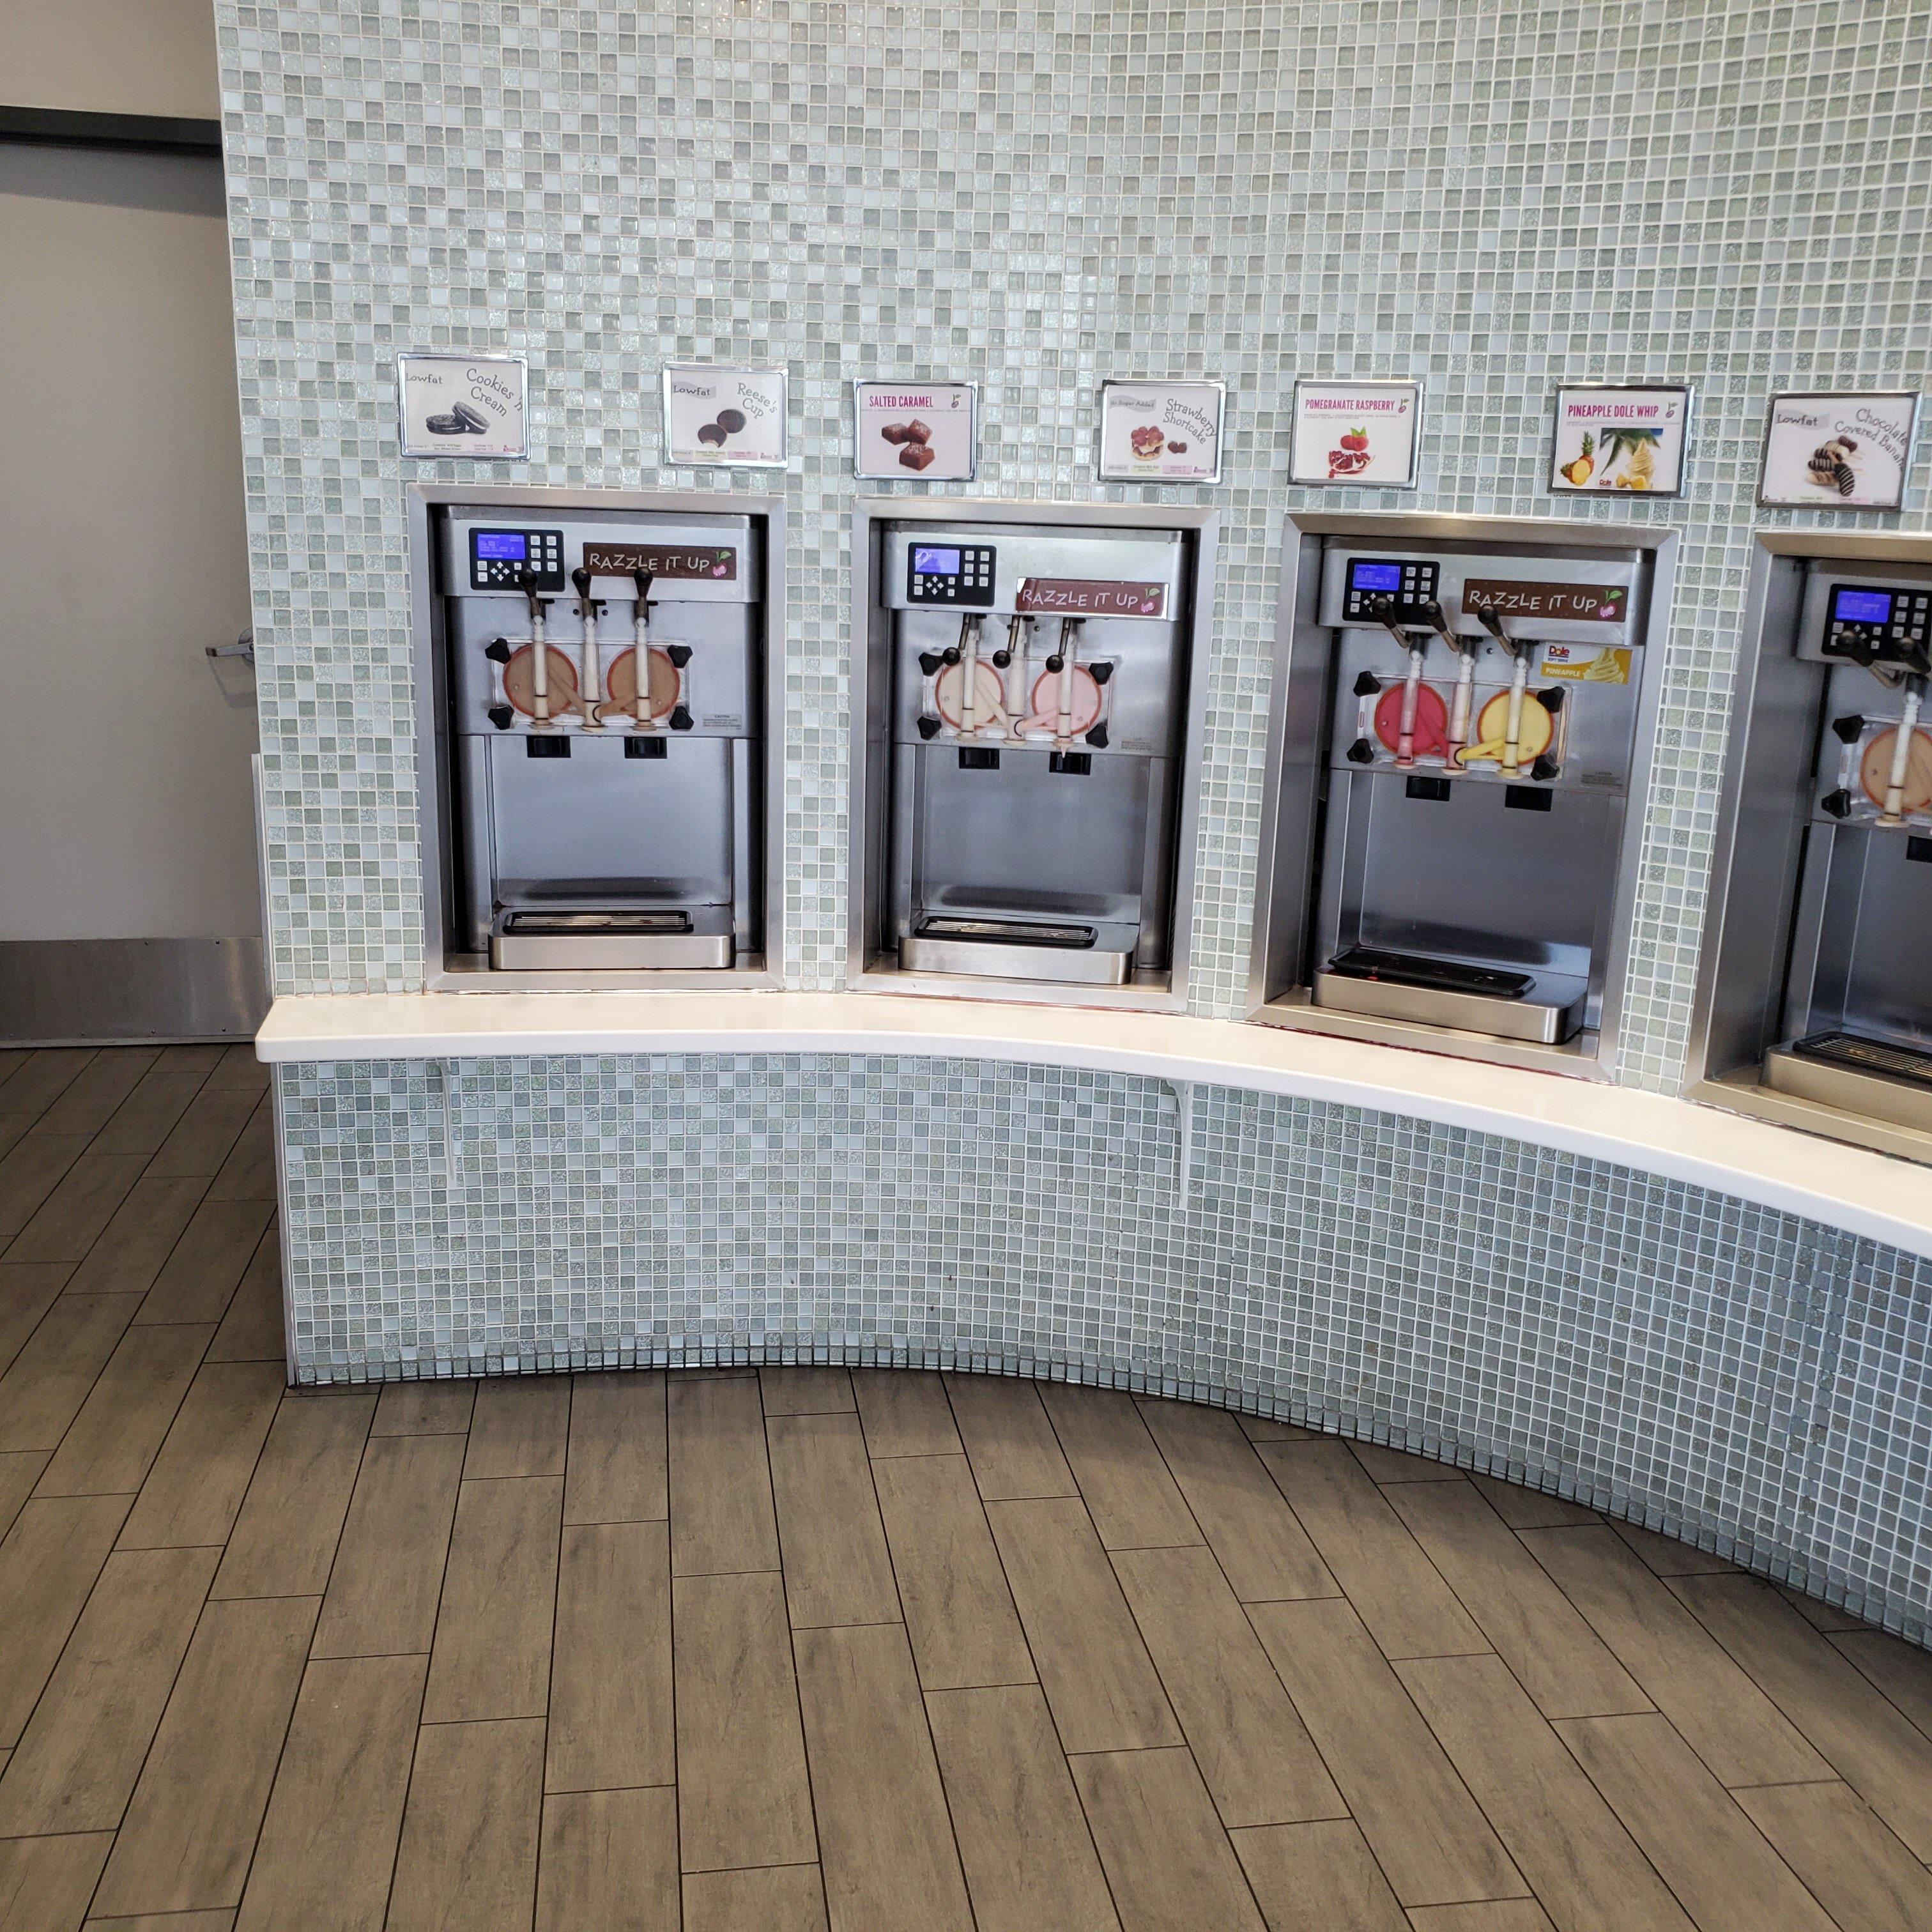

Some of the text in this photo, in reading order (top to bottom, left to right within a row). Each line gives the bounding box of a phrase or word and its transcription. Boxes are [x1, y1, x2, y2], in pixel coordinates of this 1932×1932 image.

[405, 373, 443, 384] Lowfat
[466, 368, 514, 400] Cookies
[673, 385, 710, 396] Lowfat
[737, 382, 778, 413] Reese's
[470, 386, 508, 417] Cream
[742, 397, 764, 419] Cup
[869, 395, 933, 408] SALTED CARAMEL
[1305, 399, 1395, 411] POMEGRANATE RASPBERRY
[1568, 405, 1659, 418] PINEAPPLE DOLE WHIP
[1166, 398, 1217, 437] Strawberry
[1775, 413, 1818, 426] Lowfat
[1855, 408, 1908, 446] Chocolate
[1163, 412, 1206, 445] Shortcake
[1834, 420, 1880, 441] Covered
[589, 553, 710, 572] RAZZLE IT UP
[1022, 588, 1138, 609] RAZZLE IT UP
[1469, 590, 1597, 613] RAZZLE IT UP
[1549, 645, 1570, 656] Dole
[1546, 668, 1581, 677] PINEAPPLE
